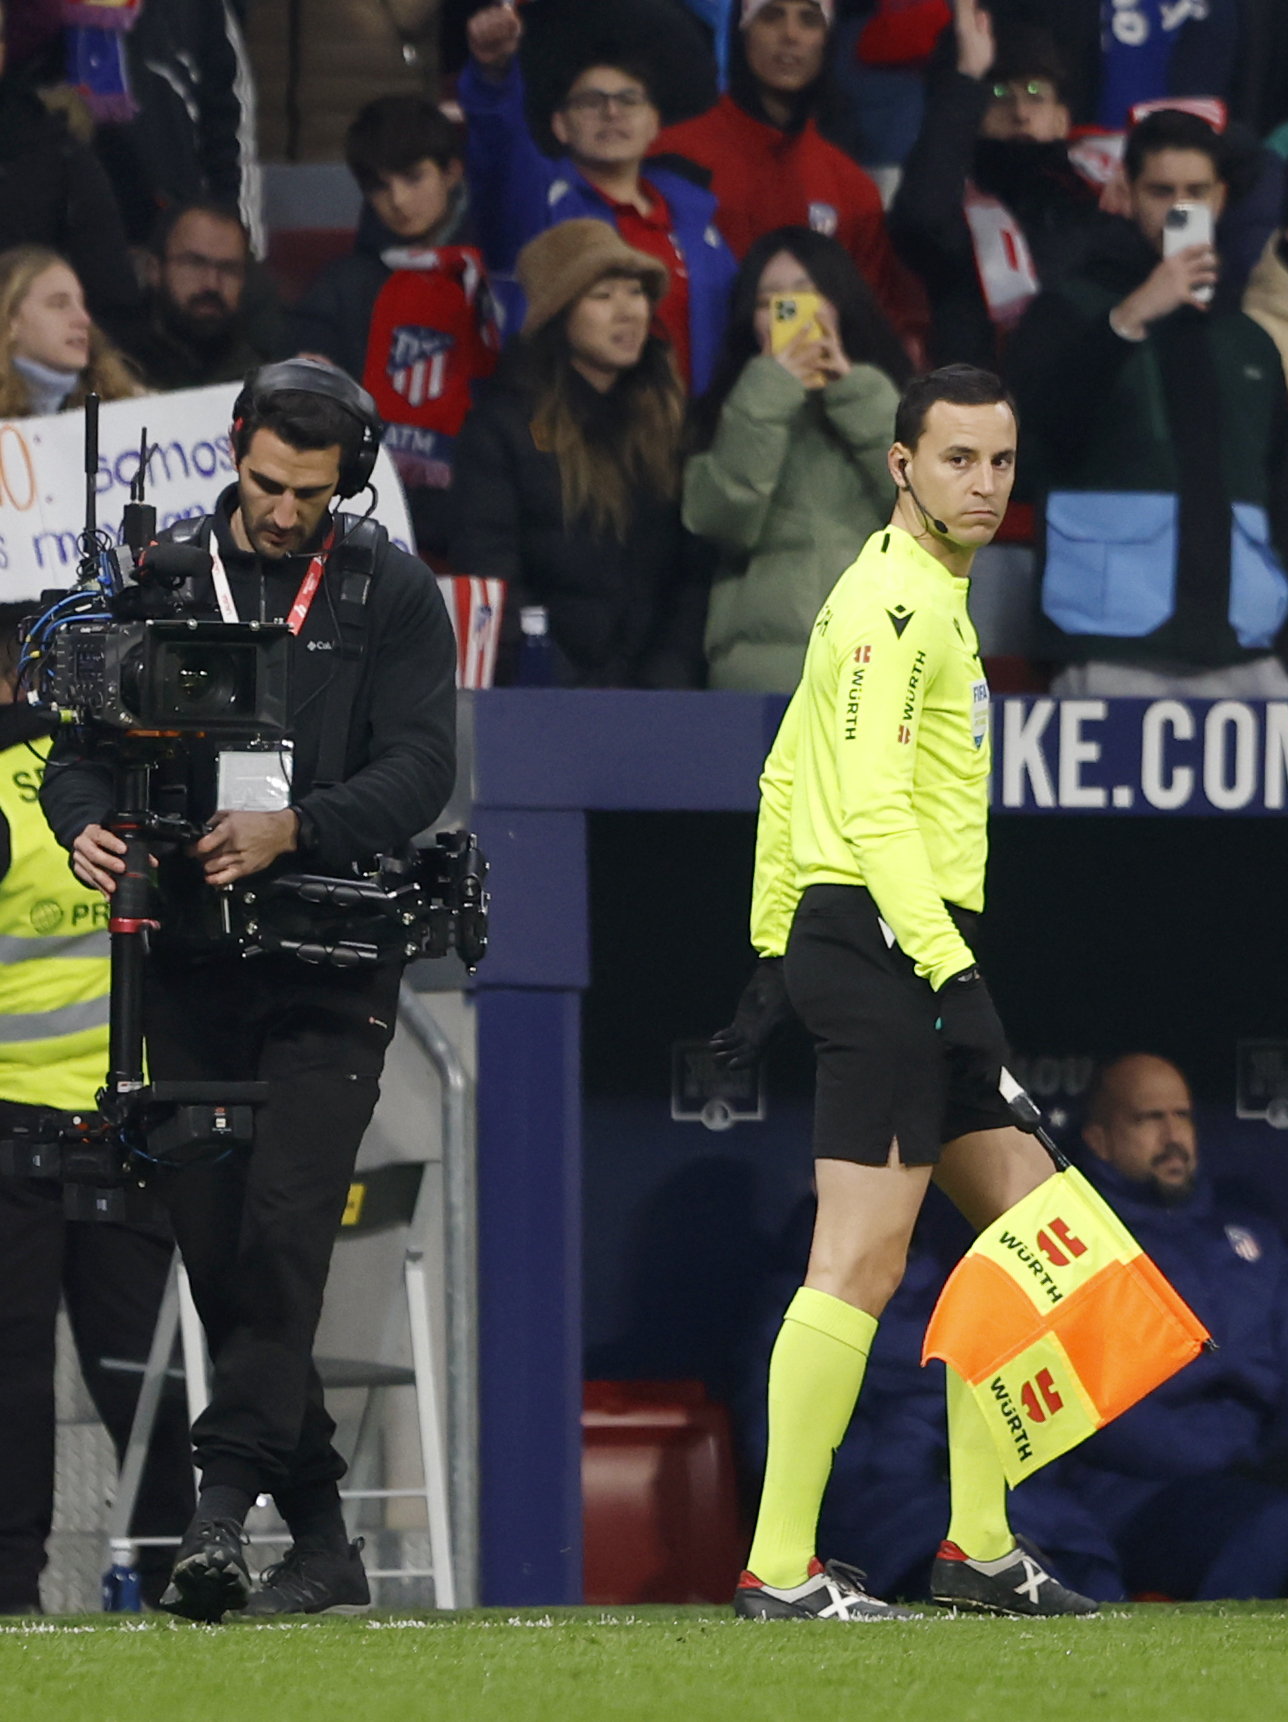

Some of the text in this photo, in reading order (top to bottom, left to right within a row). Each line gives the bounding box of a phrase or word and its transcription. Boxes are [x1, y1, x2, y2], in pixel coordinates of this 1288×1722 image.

[95, 436, 232, 494] somos
[384, 425, 435, 453] ATM
[845, 669, 865, 741] WÜRTH
[973, 684, 988, 704] FIFA
[999, 1230, 1064, 1304] WÜRTH
[990, 1376, 1034, 1462] WÜRTH
